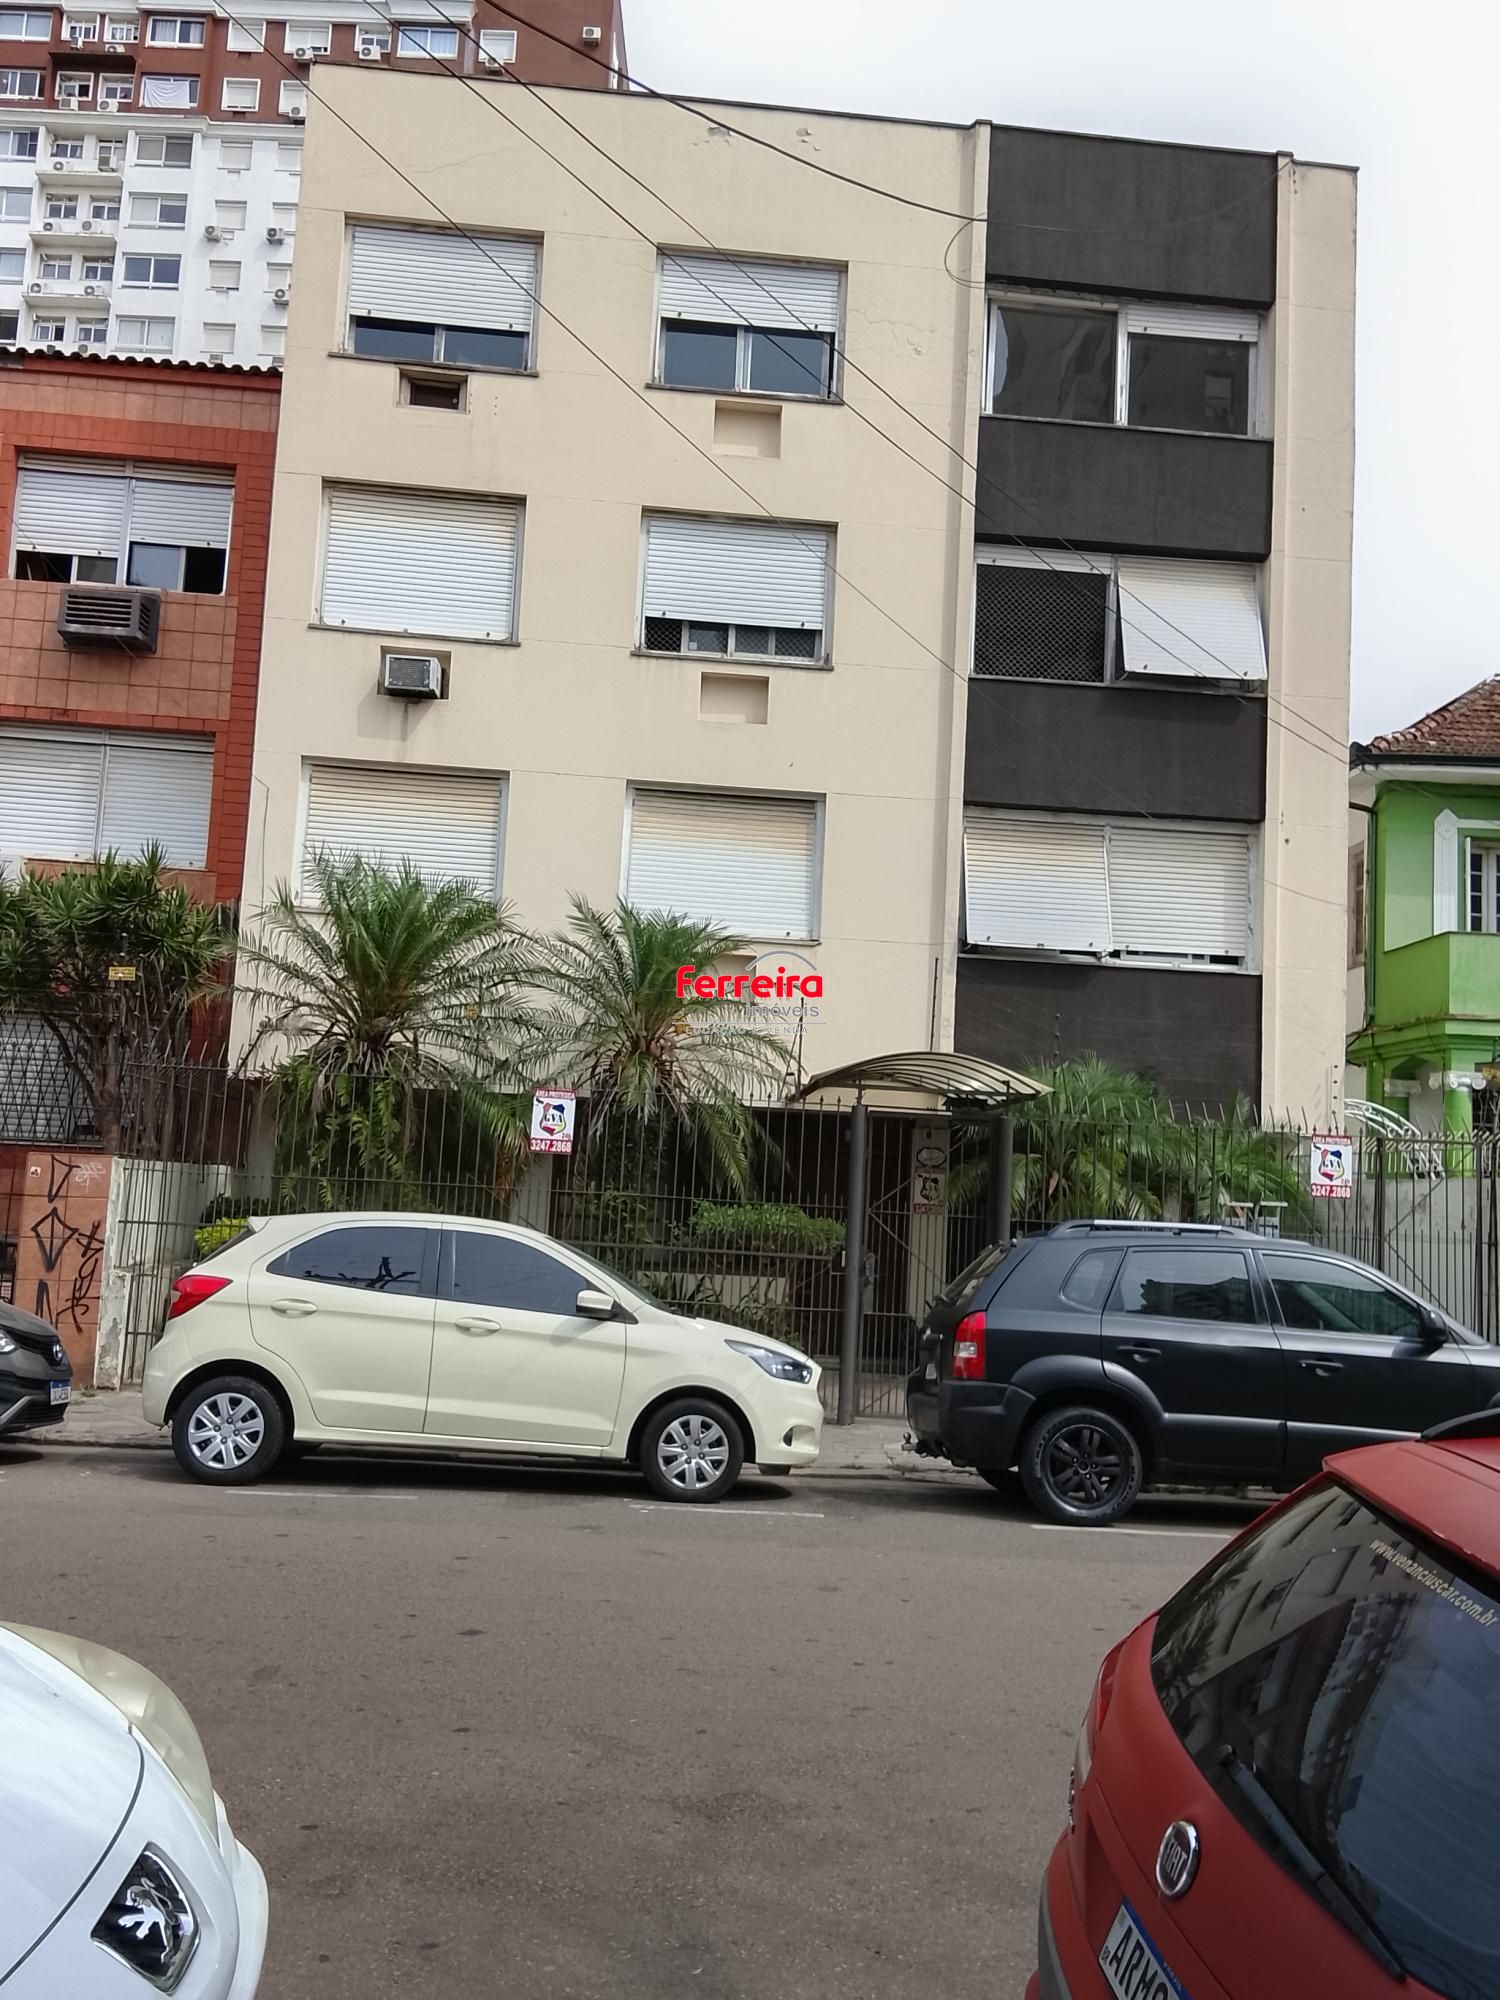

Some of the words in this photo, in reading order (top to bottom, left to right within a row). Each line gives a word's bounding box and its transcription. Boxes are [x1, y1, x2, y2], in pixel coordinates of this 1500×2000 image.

[530, 1139, 571, 1152] 3247.2868
[1311, 1184, 1351, 1198] 3247.2868
[1369, 1539, 1498, 1626] www.venanciuscar.com.br
[1162, 1837, 1188, 1881] FIAT
